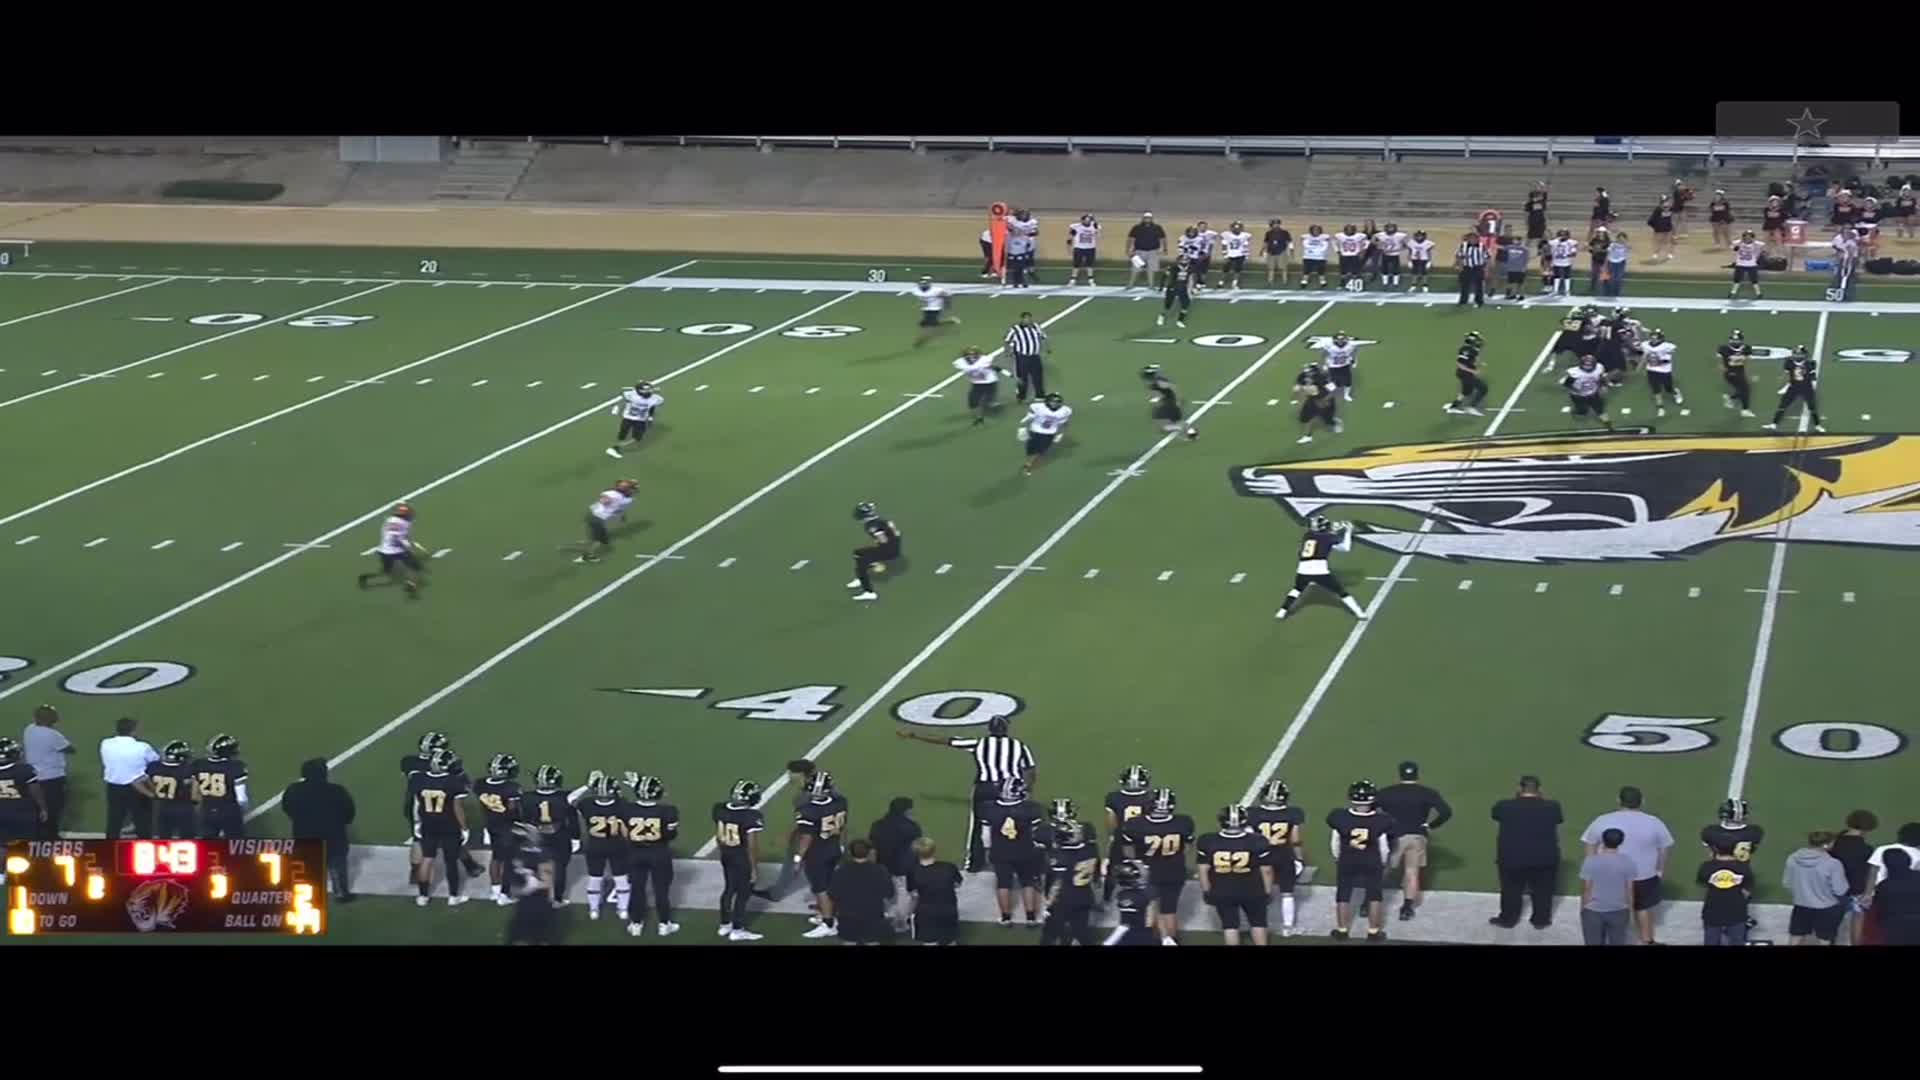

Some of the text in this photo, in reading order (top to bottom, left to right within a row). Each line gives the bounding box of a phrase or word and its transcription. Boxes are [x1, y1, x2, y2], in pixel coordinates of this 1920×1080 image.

[420, 260, 438, 274] 20
[868, 269, 886, 283] 30
[1345, 278, 1363, 292] 40
[1825, 288, 1844, 301] 50
[152, 775, 177, 800] 27
[420, 789, 447, 813] 17
[538, 800, 552, 824] 1
[628, 816, 662, 842] 23
[1000, 816, 1018, 840] 4
[1351, 828, 1370, 850] 2
[1144, 834, 1181, 857] 70
